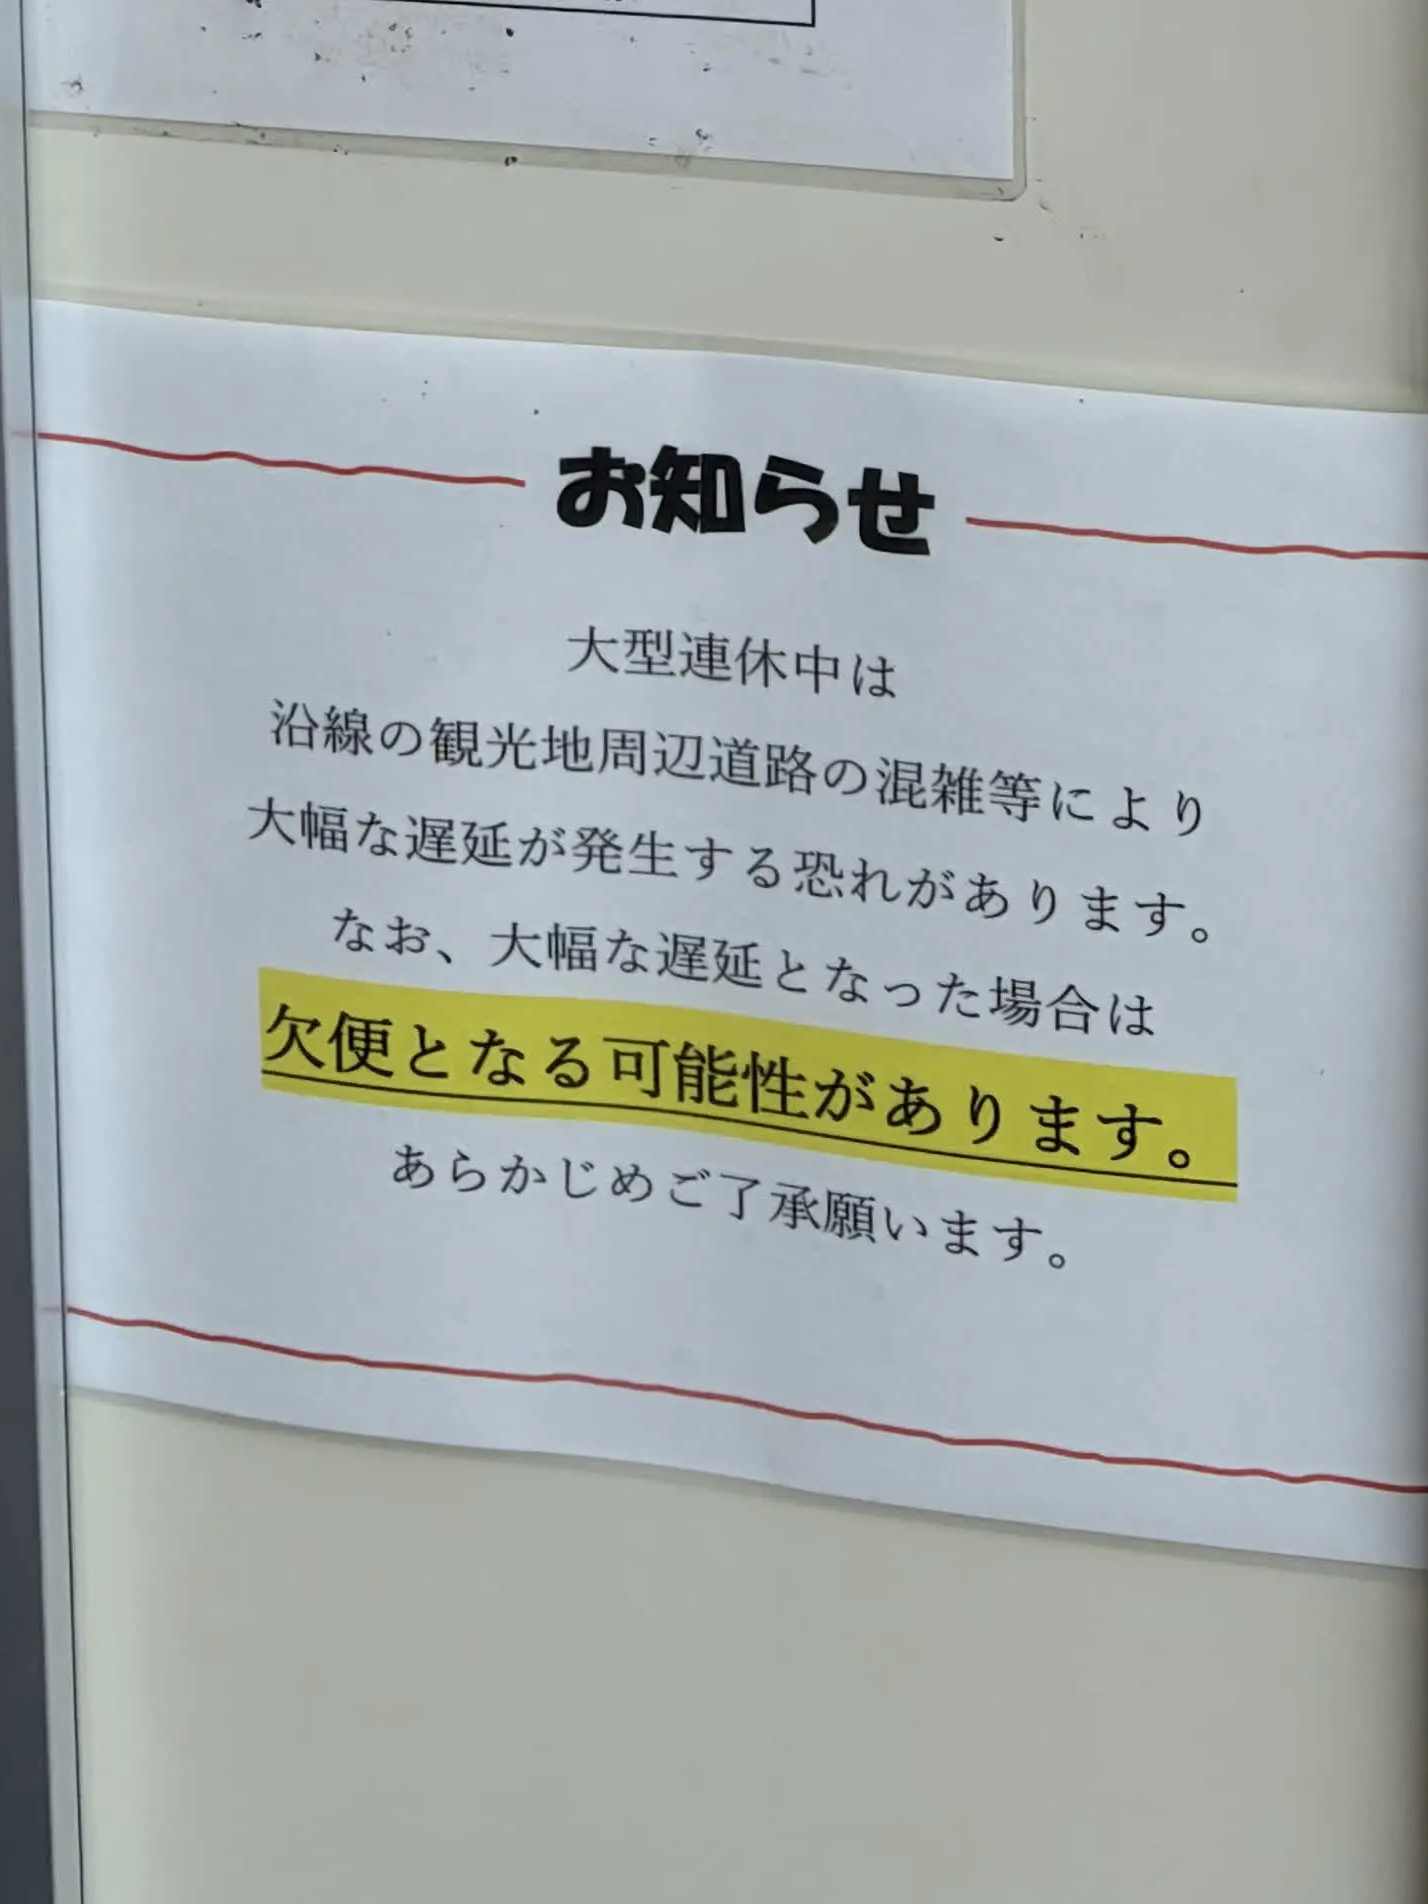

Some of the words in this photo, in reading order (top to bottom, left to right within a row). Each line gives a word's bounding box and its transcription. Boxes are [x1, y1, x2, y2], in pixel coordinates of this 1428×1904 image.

[556, 444, 936, 557] お知らせ
[566, 625, 899, 701] 大型連休中は
[268, 696, 1205, 838] 沿線の観光地周辺道路の混雑等により
[247, 795, 1212, 946] 大幅な遅延が発生する恐れがあります。
[331, 907, 1157, 1039] なお、大幅な遅延となった場合は
[264, 1002, 1195, 1173] 欠便となる可能性があります。
[390, 1142, 1070, 1271] あらかじめご了承願います。
